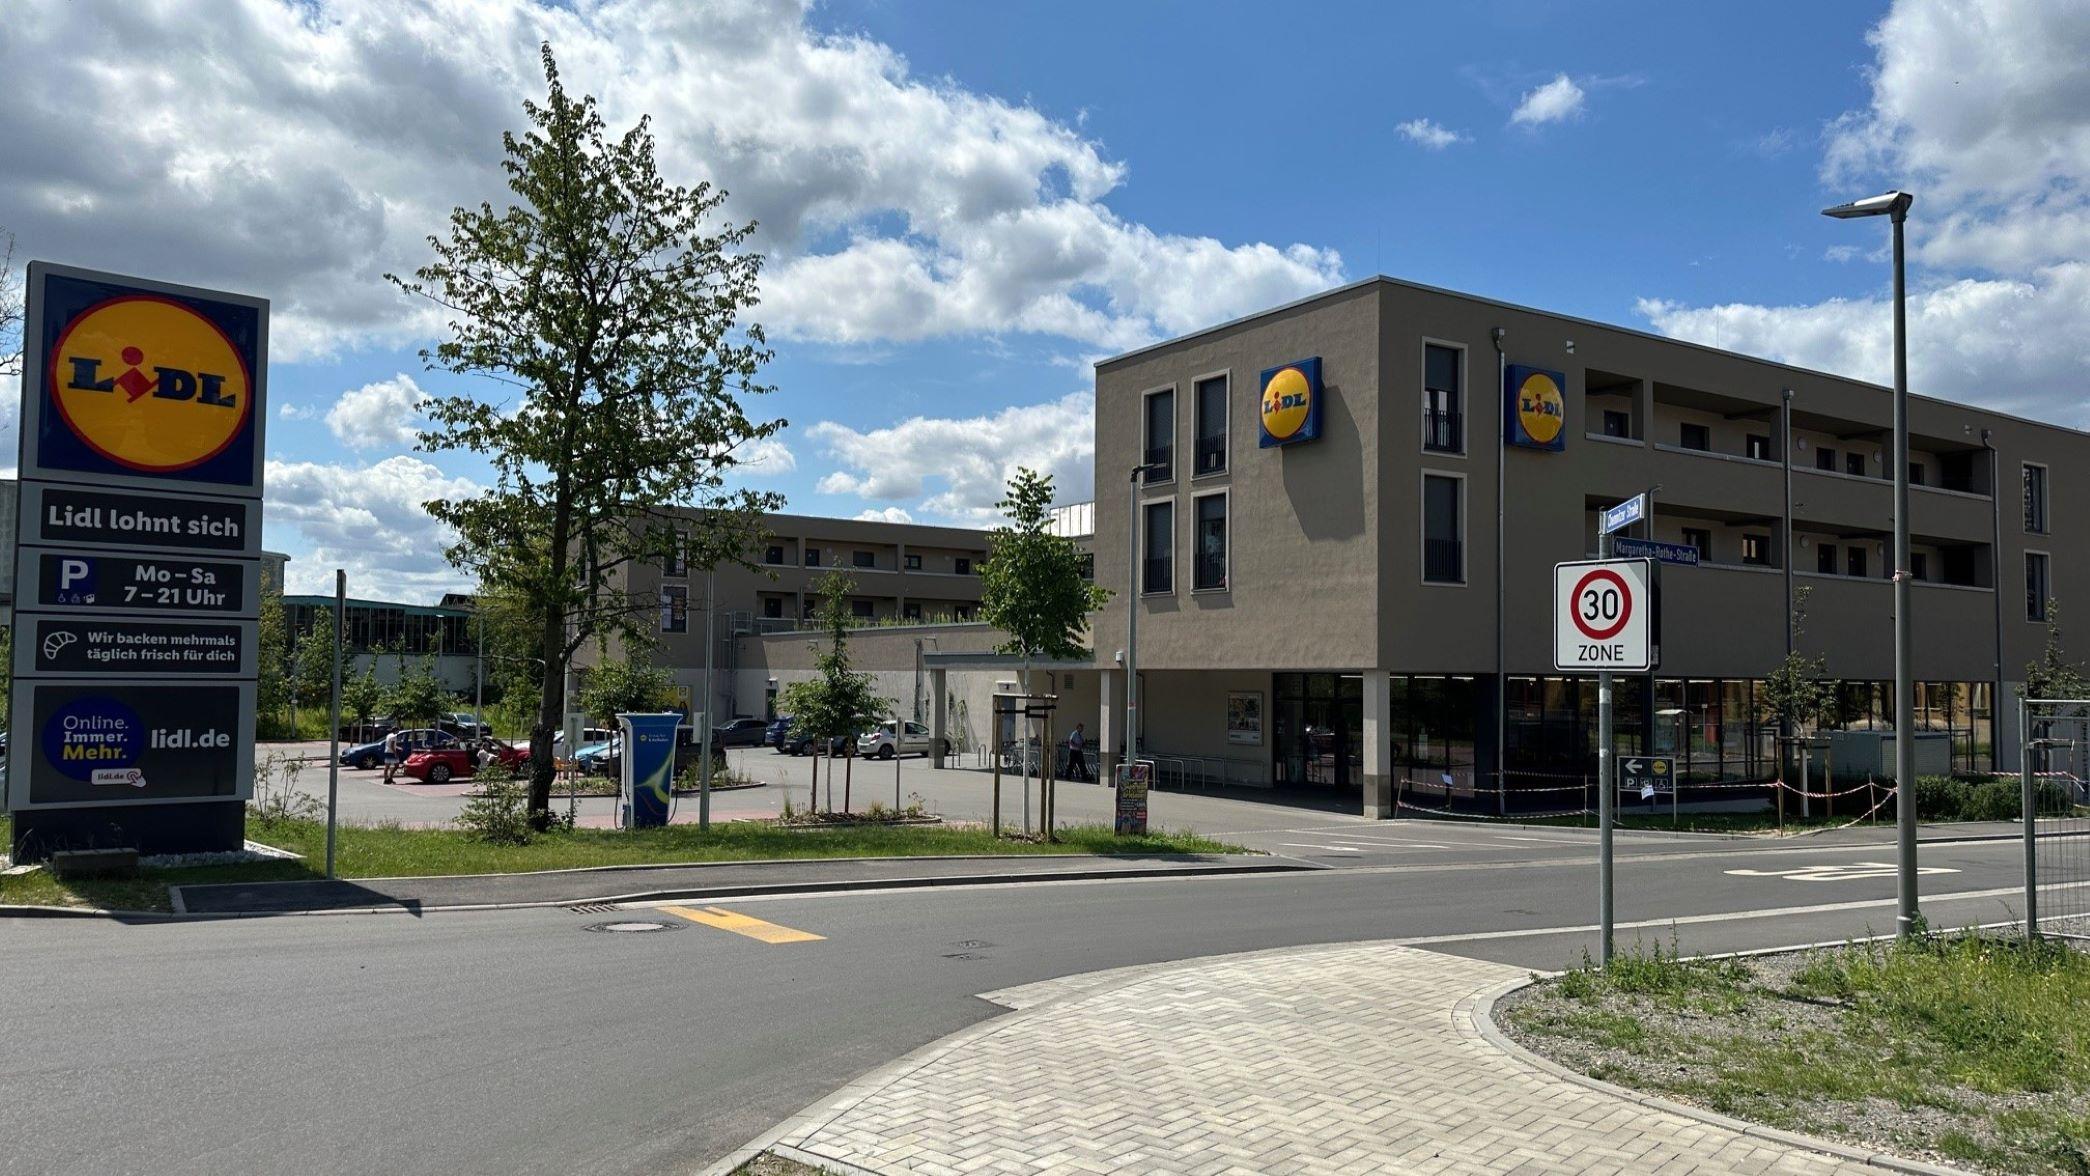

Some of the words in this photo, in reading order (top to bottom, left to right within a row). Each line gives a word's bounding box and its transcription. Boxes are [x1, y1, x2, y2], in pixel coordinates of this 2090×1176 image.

[49, 505, 102, 528] Lidl
[110, 509, 181, 533] lohnt
[187, 515, 239, 537] sich
[61, 560, 89, 590] P
[135, 565, 171, 582] Mo
[191, 567, 216, 585] Sa
[124, 586, 138, 602] 7
[157, 588, 179, 604] 21
[186, 589, 226, 606] Uhr
[1584, 588, 1619, 621] 30
[88, 632, 114, 643] Wir
[117, 633, 167, 645] backen
[171, 634, 235, 646] mehrmals
[87, 649, 137, 662] täglich
[141, 649, 180, 661] frisch
[183, 650, 203, 661] für
[206, 650, 235, 661] dich
[1578, 645, 1624, 661] ZONE
[63, 715, 129, 730] Online.
[64, 731, 128, 743] Immer.
[151, 729, 230, 748] lidl.de
[63, 745, 127, 760] Mehr.
[97, 773, 125, 781] lidl.de
[1626, 778, 1635, 788] P
